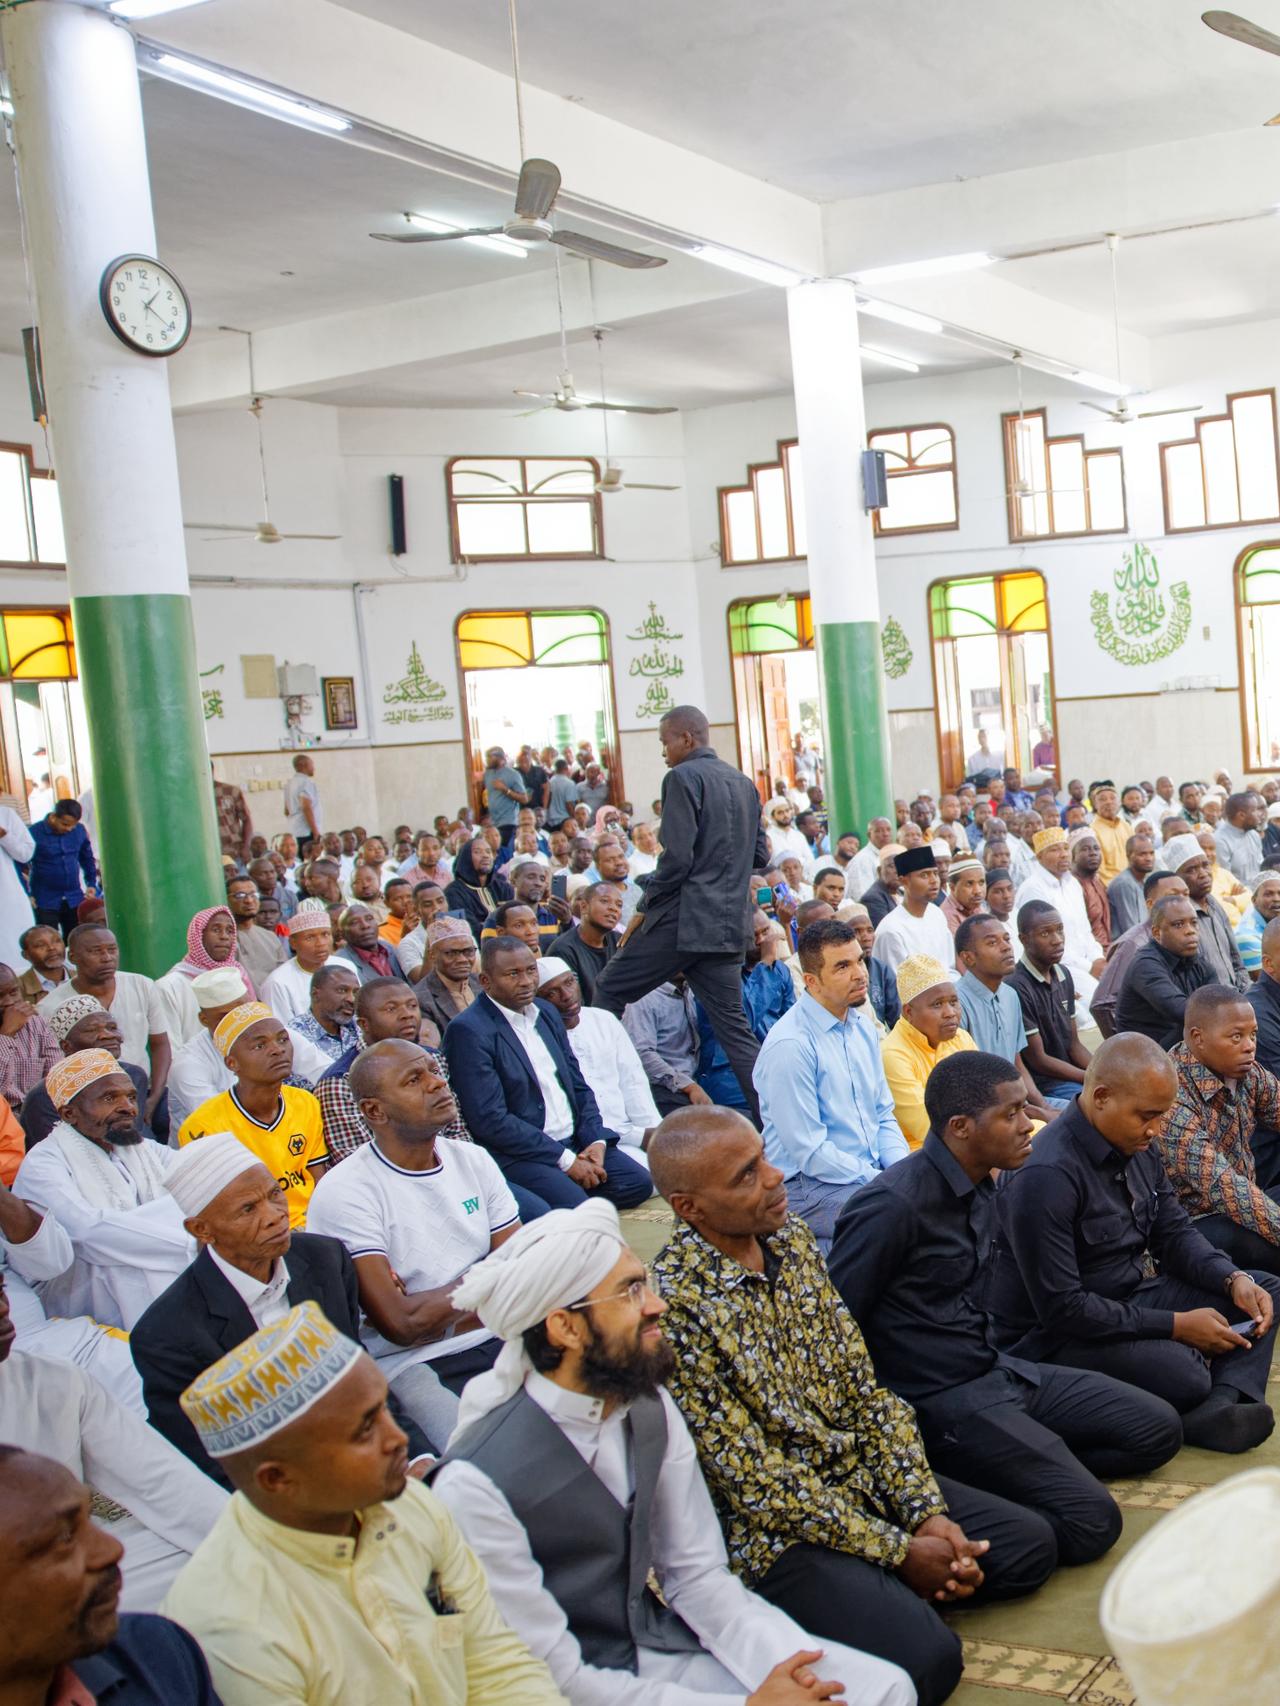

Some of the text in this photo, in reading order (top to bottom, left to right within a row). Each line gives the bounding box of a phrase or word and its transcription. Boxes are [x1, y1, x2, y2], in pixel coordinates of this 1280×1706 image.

[125, 271, 133, 282] 11
[138, 268, 148, 280] 12
[116, 281, 126, 292] 10
[166, 290, 173, 301] 2
[113, 296, 120, 306] 9
[171, 306, 178, 316] 3
[119, 312, 126, 322] 8
[130, 325, 137, 335] 7
[160, 330, 167, 340] 5
[146, 332, 153, 343] 6
